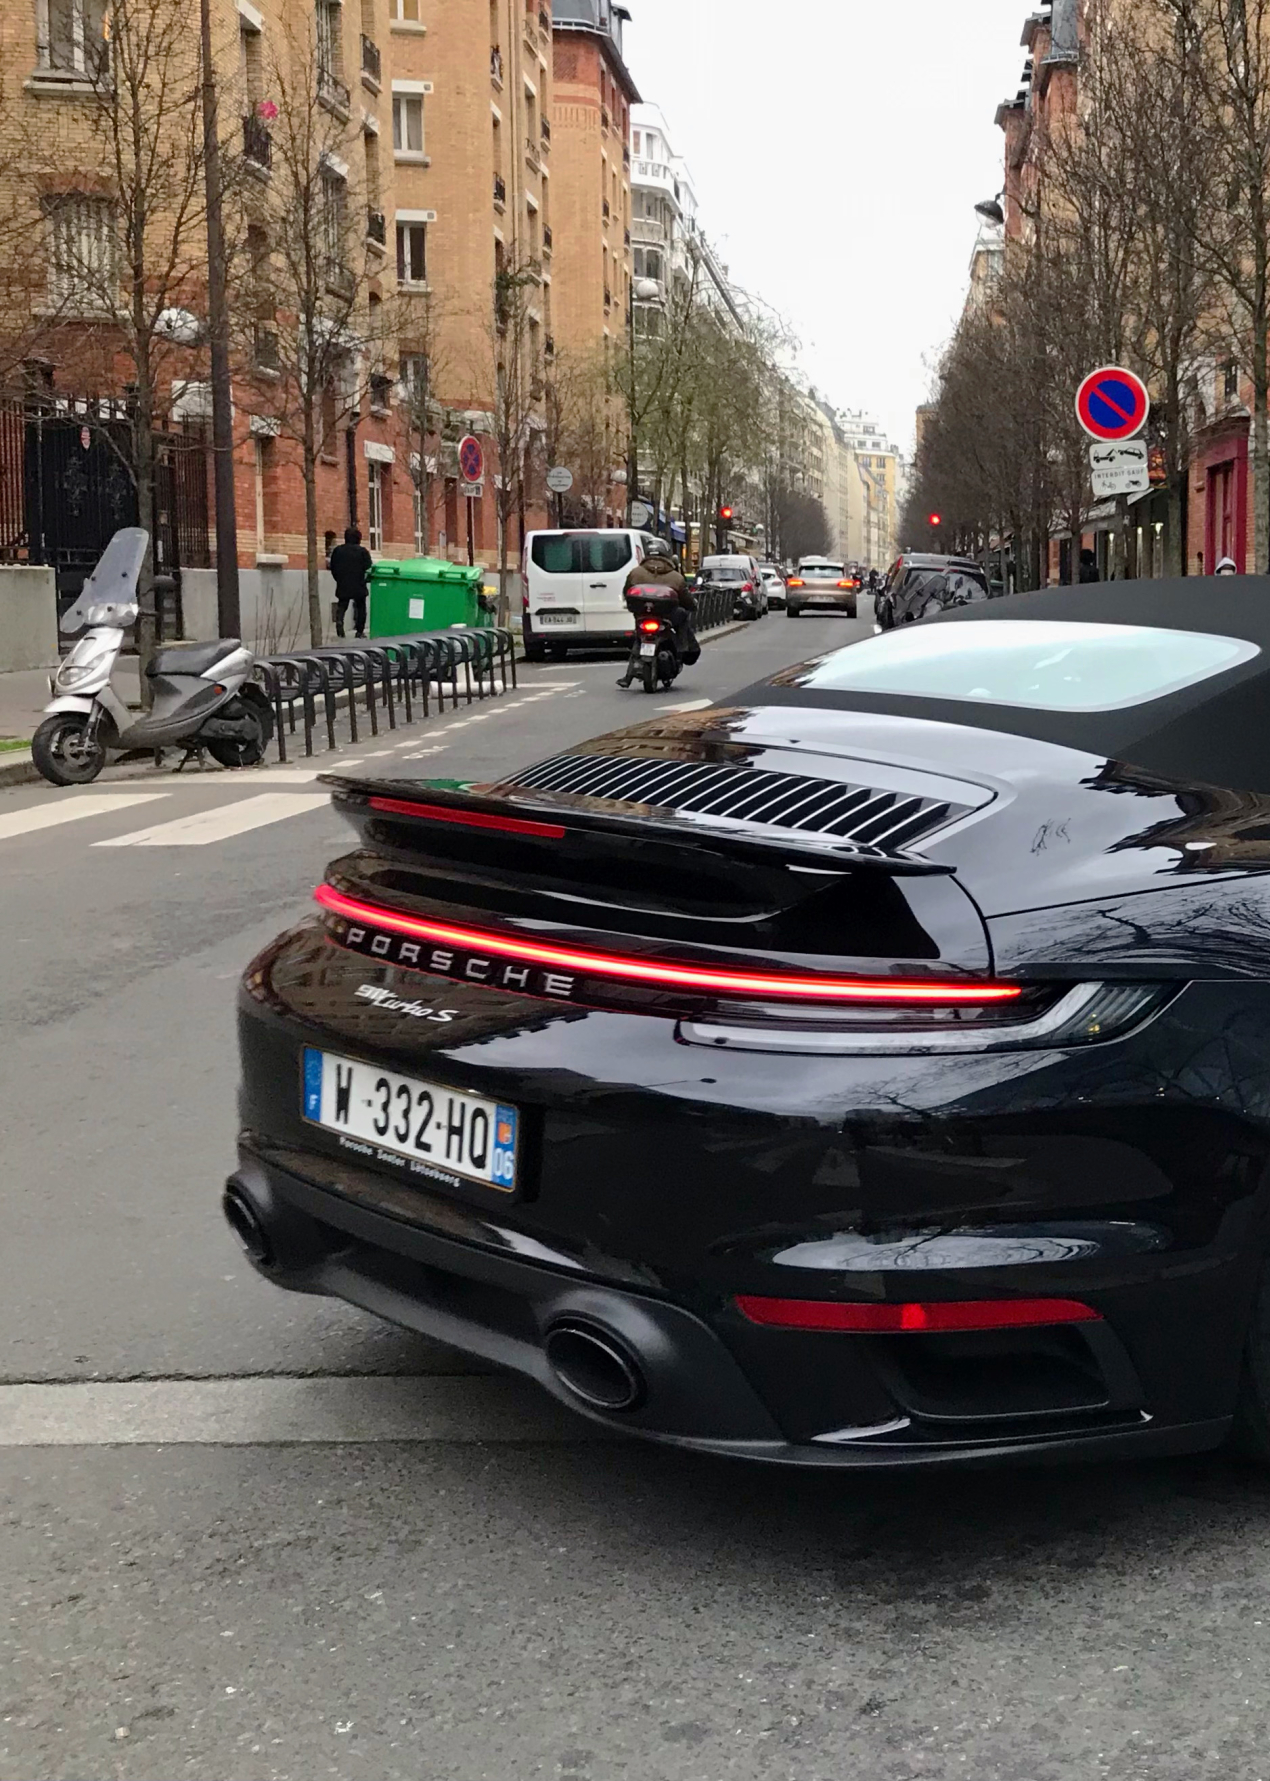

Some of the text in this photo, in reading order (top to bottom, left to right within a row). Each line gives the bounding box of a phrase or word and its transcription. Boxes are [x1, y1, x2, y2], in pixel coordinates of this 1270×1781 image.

[1094, 470, 1125, 479] INTERDIT
[345, 927, 575, 997] PORSCHE
[373, 992, 433, 1017] turbo
[426, 1009, 460, 1023] S
[494, 1148, 514, 1180] 06
